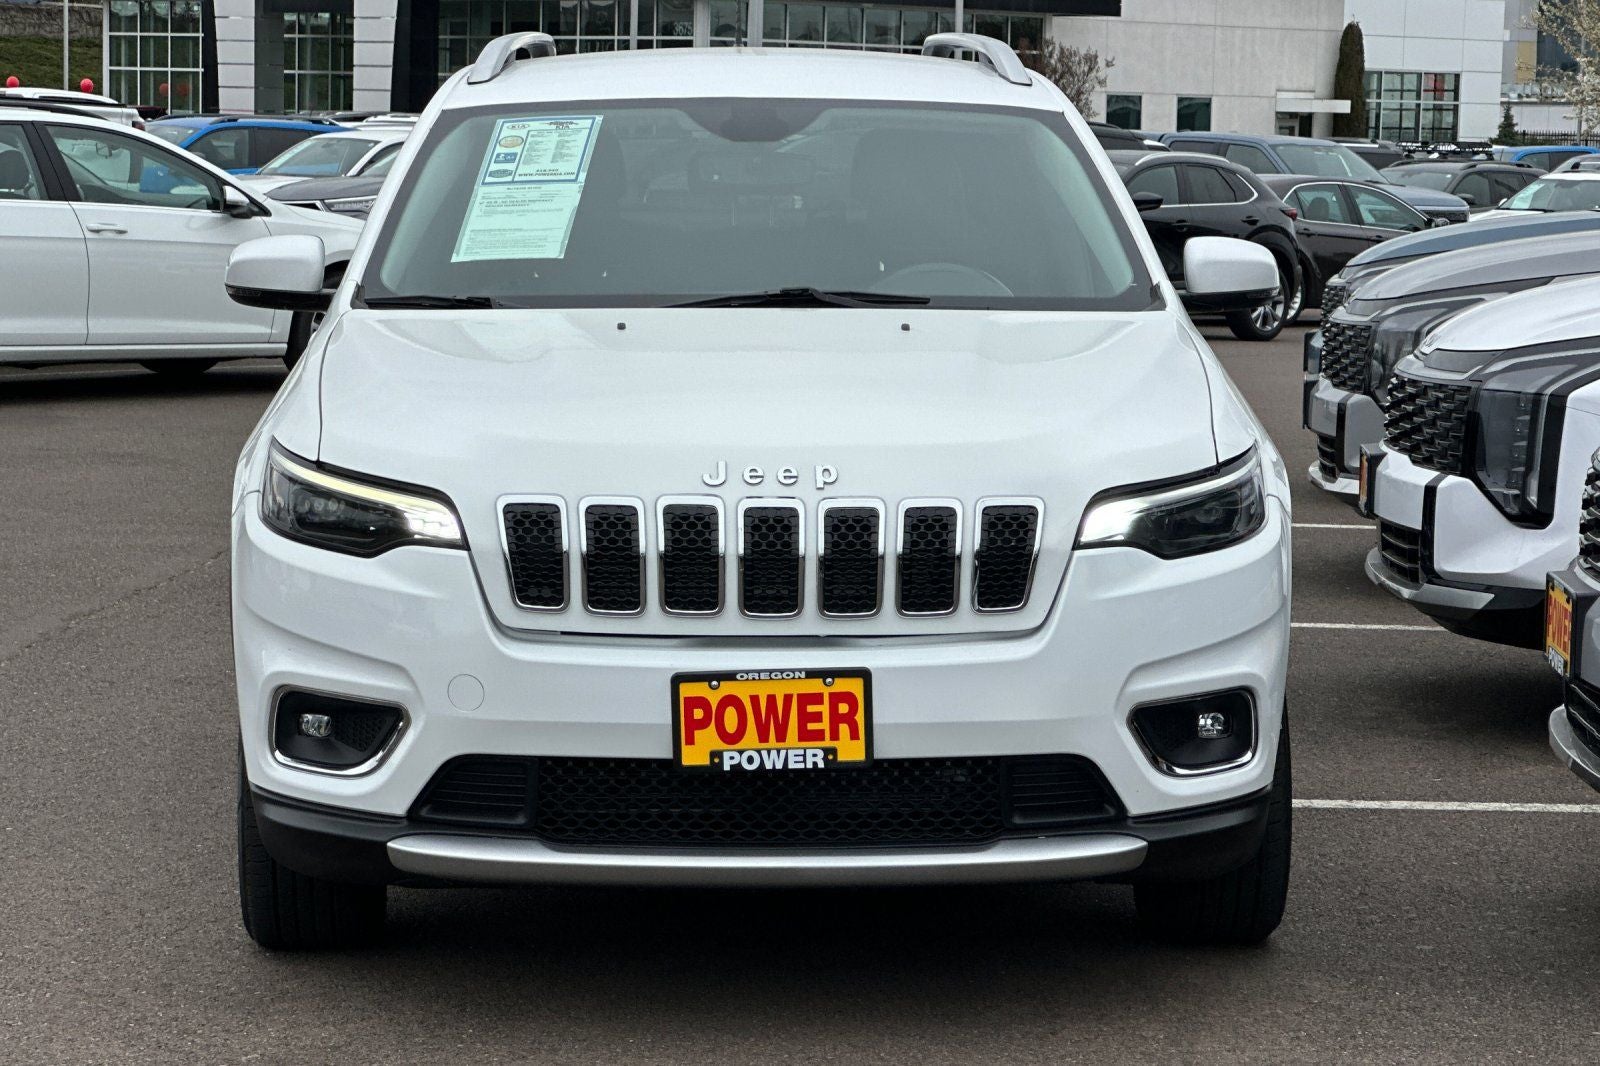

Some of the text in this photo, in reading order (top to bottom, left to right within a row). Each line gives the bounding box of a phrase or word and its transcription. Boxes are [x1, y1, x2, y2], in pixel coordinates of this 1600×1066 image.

[702, 460, 838, 490] Jeep
[736, 671, 806, 681] OREGON
[683, 691, 860, 746] POWER
[723, 748, 825, 771] POWER
